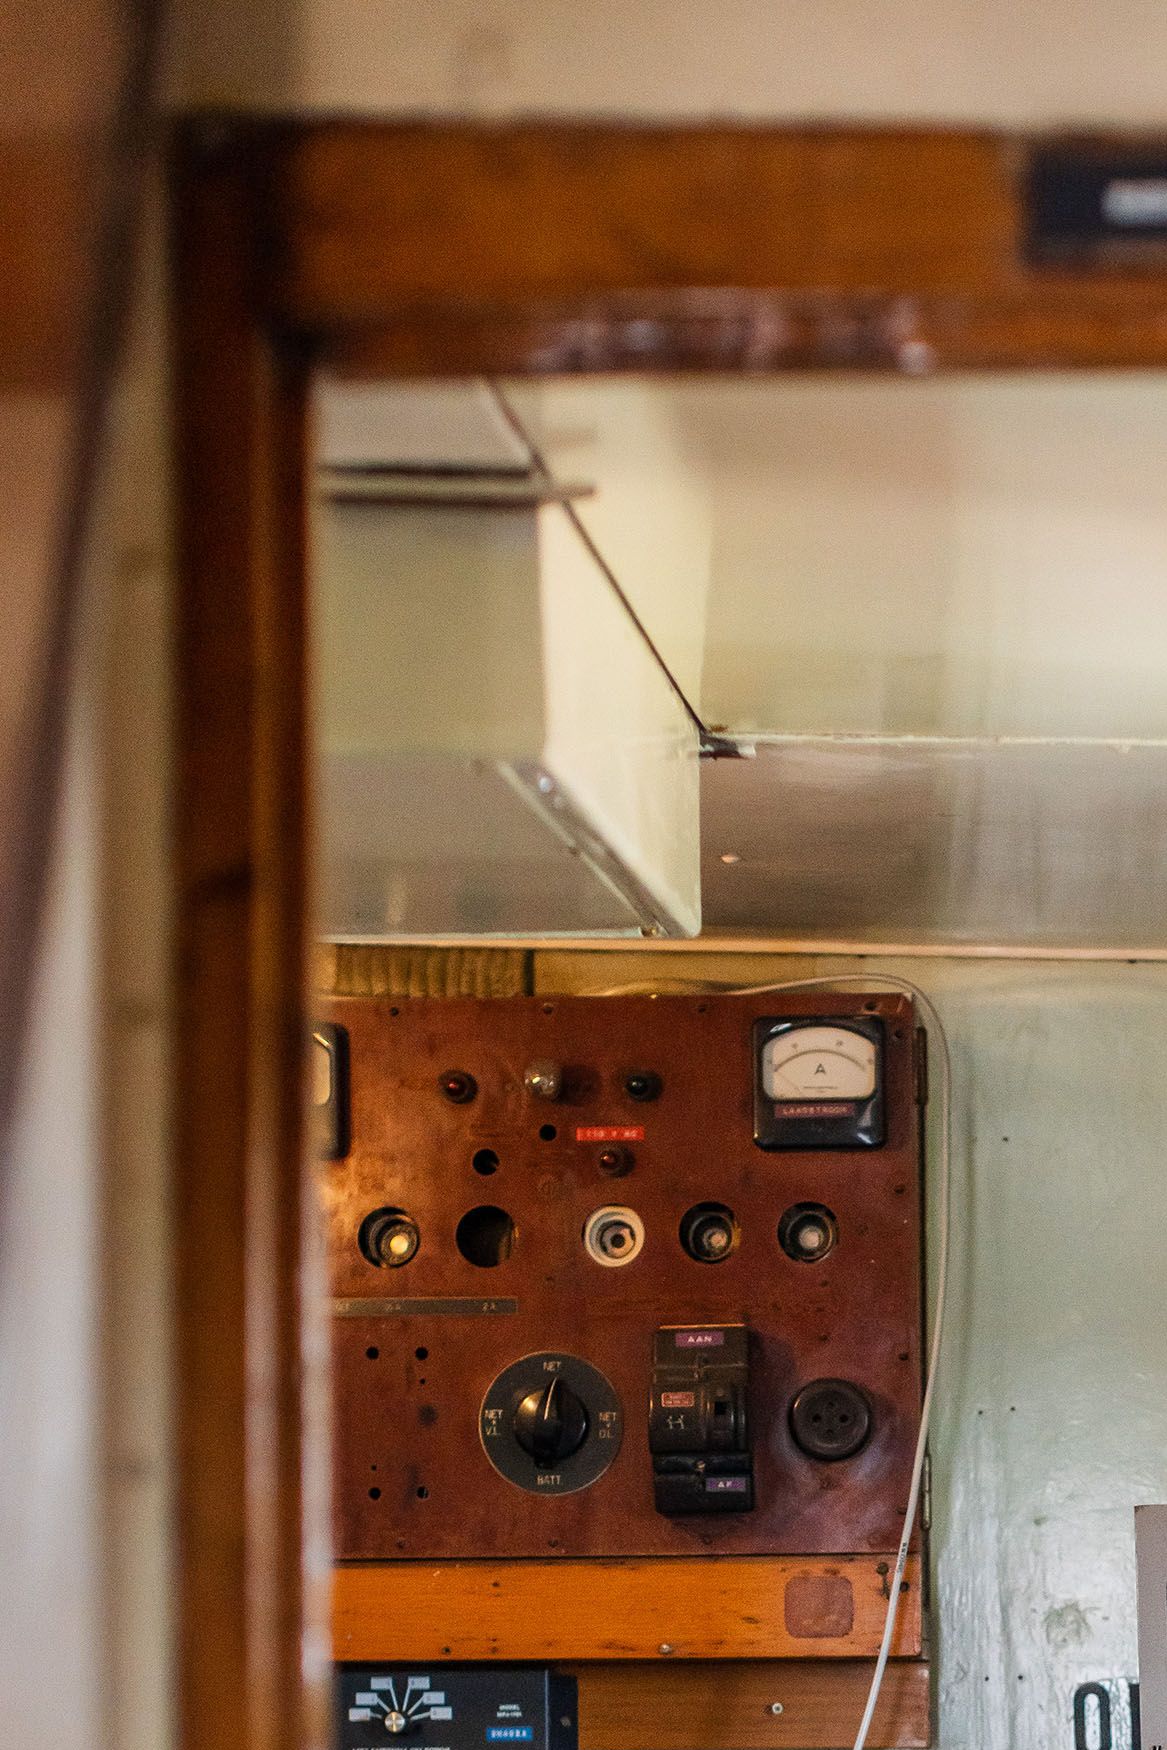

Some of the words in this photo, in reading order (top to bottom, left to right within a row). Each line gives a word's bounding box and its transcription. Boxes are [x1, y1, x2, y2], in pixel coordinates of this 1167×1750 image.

[815, 1063, 826, 1075] A
[687, 1335, 713, 1343] AAN
[543, 1361, 562, 1371] NET
[485, 1409, 503, 1419] NET
